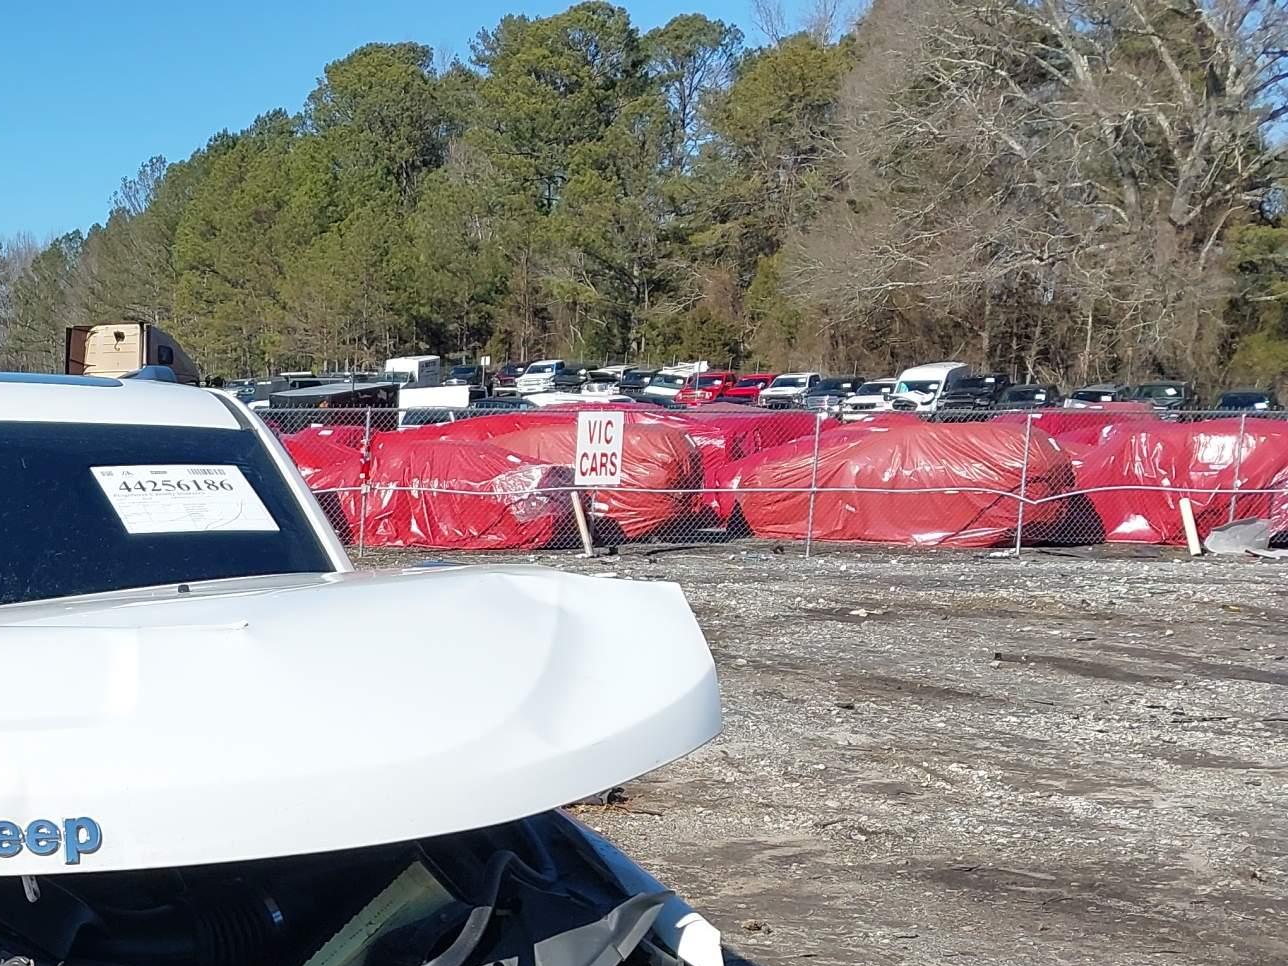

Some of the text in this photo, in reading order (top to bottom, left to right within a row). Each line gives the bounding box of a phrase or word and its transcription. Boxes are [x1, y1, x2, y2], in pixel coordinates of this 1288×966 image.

[587, 419, 615, 445] VIC
[579, 451, 618, 477] CARS
[118, 478, 234, 492] 44256186
